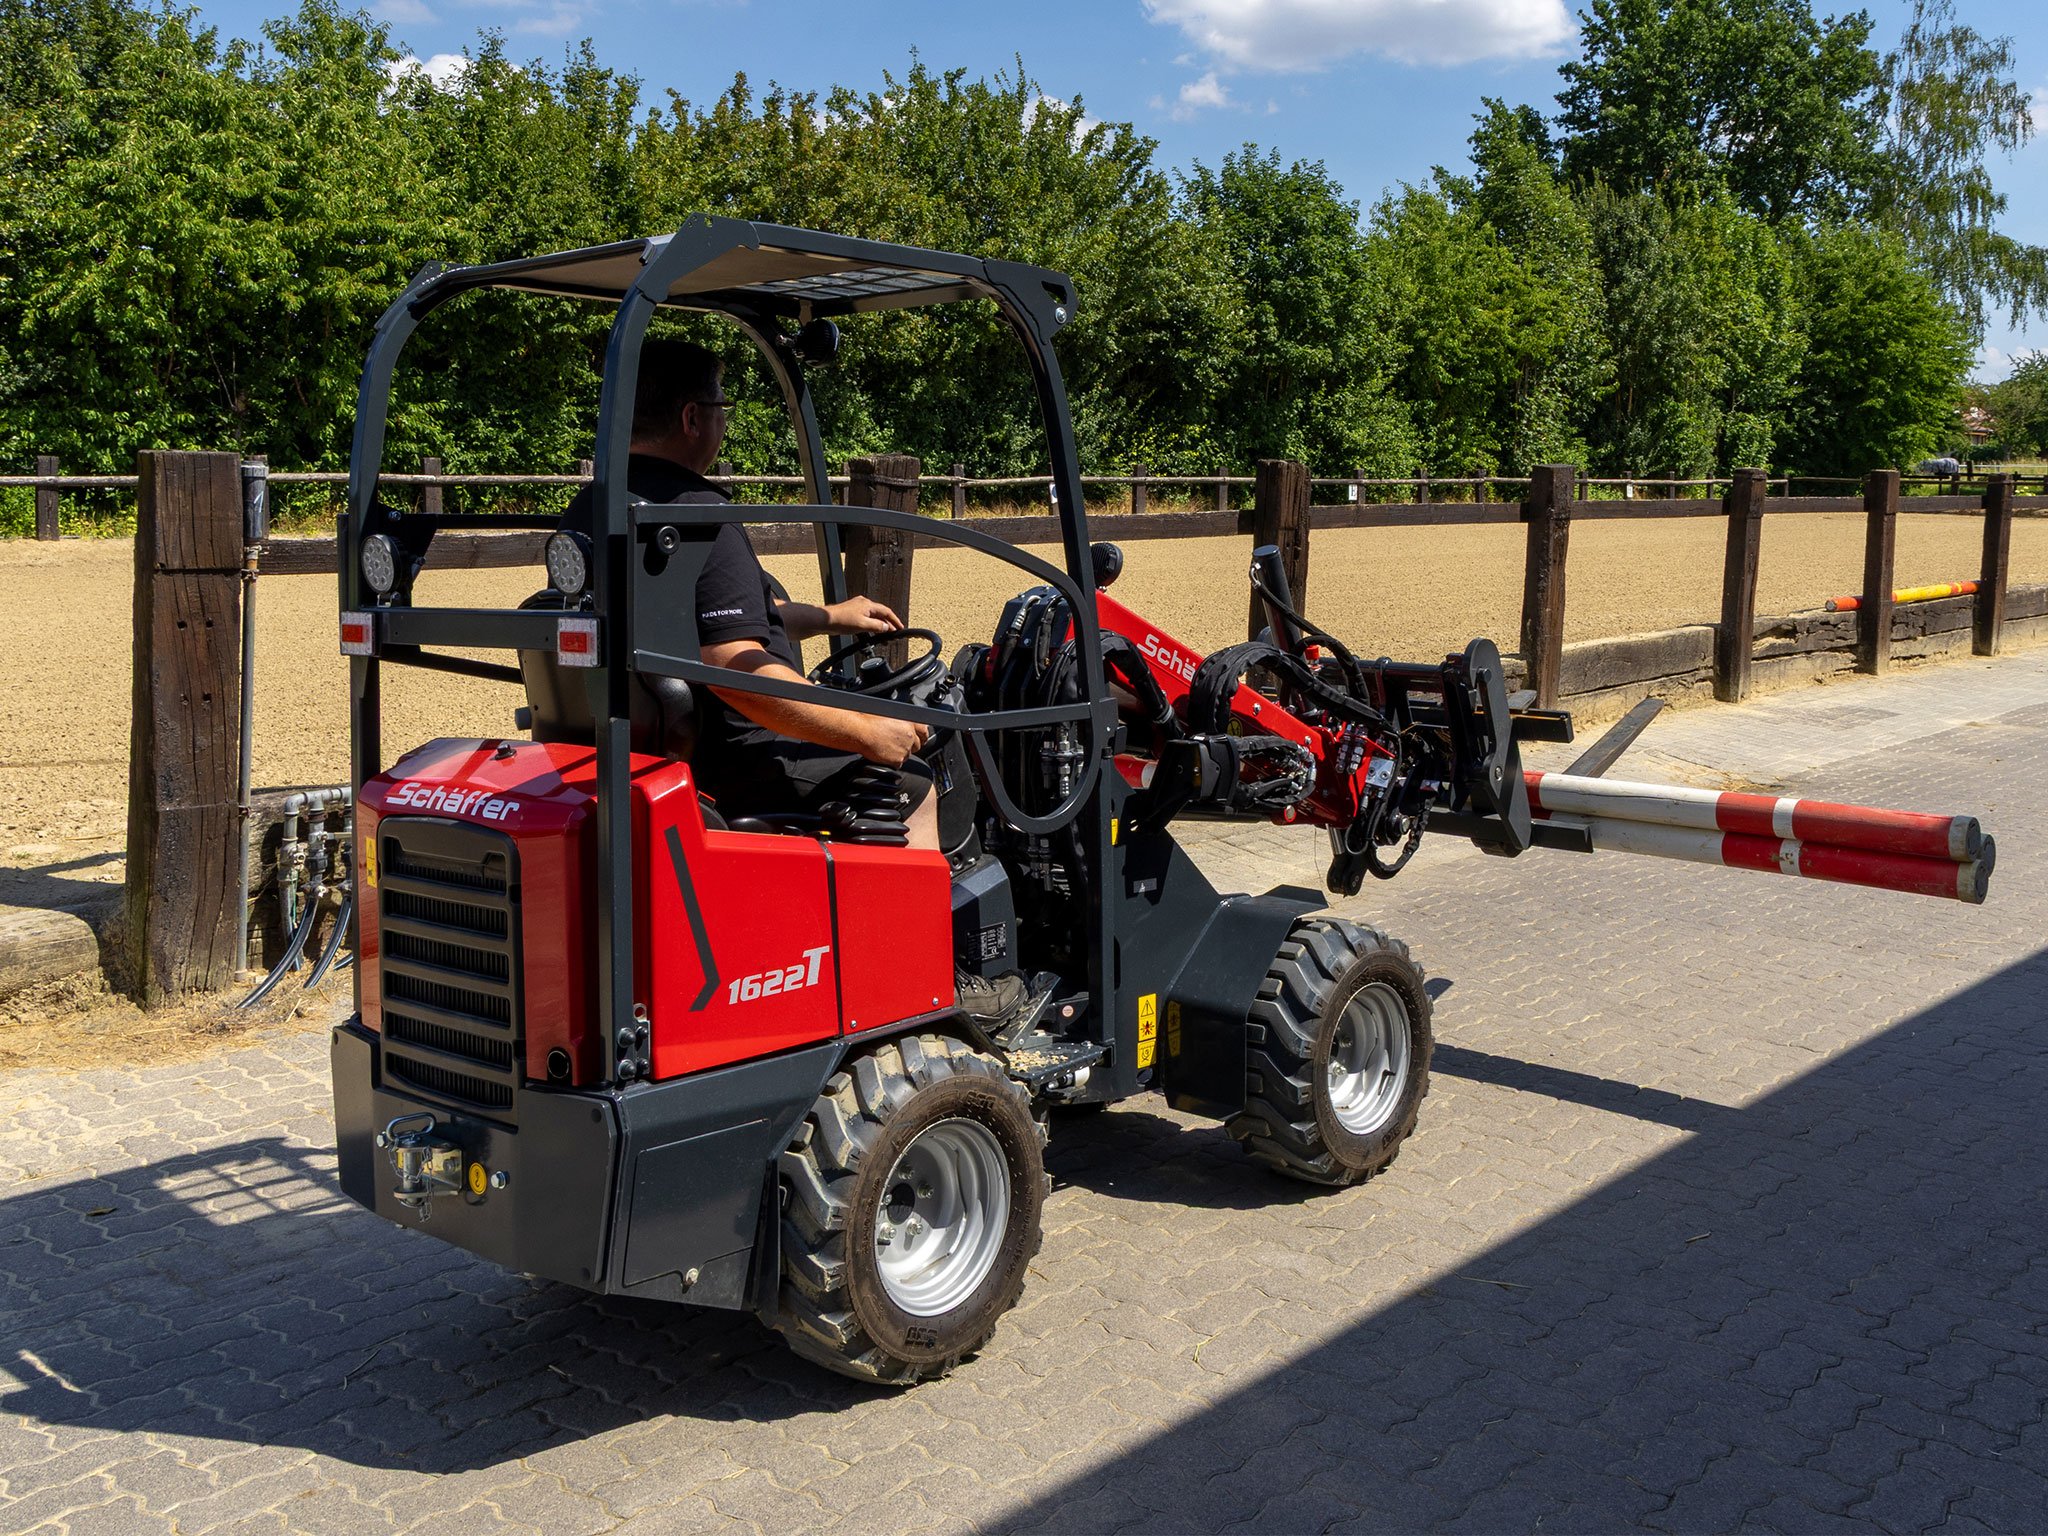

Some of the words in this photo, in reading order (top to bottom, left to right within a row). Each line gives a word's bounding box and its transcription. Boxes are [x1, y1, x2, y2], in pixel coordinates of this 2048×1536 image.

[1137, 633, 1196, 681] Schä
[386, 782, 520, 821] Schäffer
[728, 945, 830, 1005] 1622T
